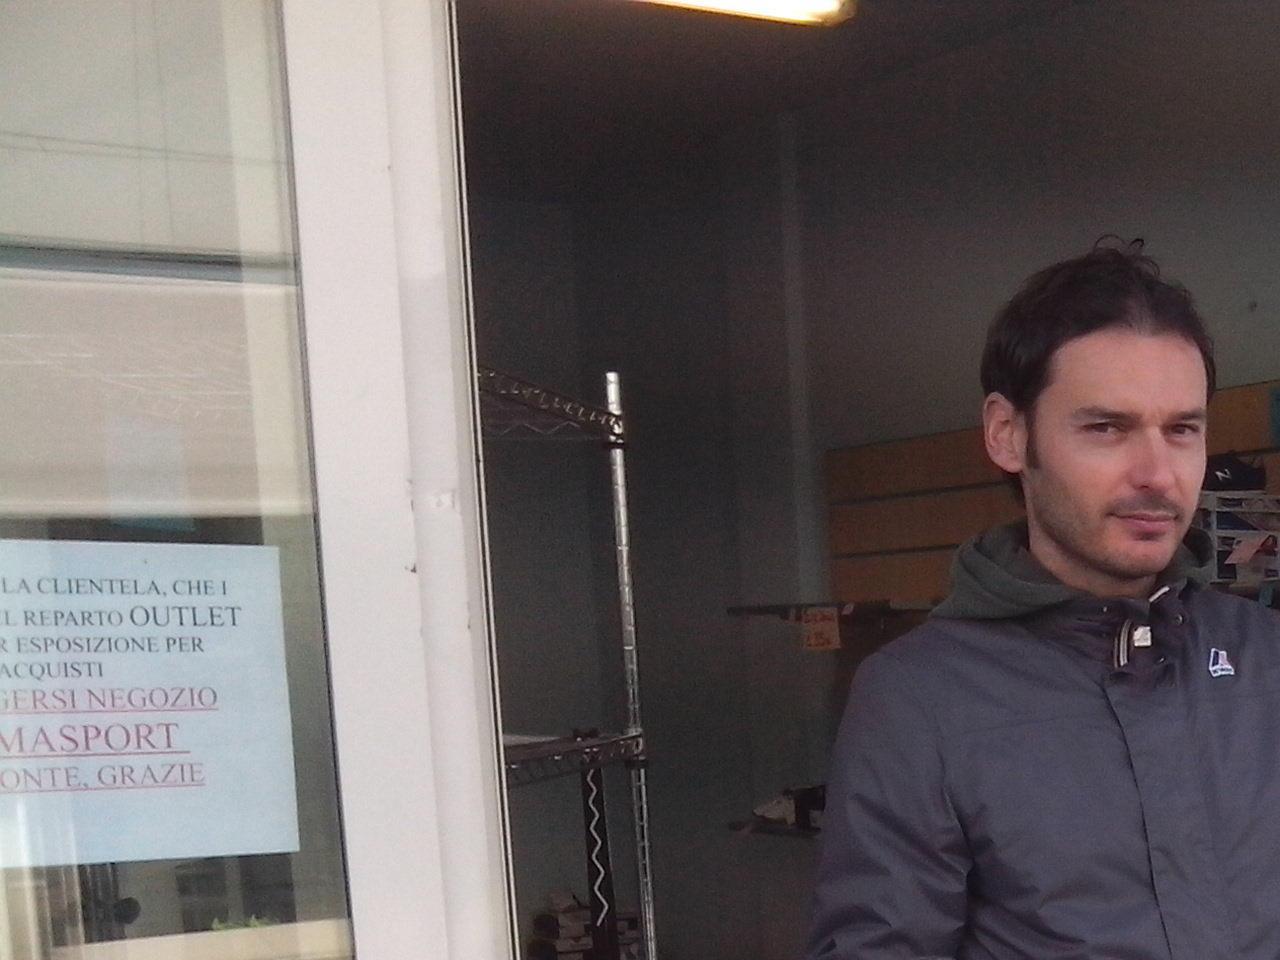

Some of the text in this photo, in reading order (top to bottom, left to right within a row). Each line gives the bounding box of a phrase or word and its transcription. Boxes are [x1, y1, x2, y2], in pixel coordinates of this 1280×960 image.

[37, 578, 167, 597] CLIENTELA,
[173, 580, 215, 595] CHE
[222, 580, 228, 595] I
[23, 610, 123, 627] REPARTO
[130, 605, 242, 627] OUTLET
[17, 637, 160, 653] ESPOSIZIONE
[166, 637, 204, 653] PER
[0, 662, 103, 681] ACQUISTI
[87, 687, 218, 709] NEGOZIO
[97, 762, 206, 787] GRAZIE
